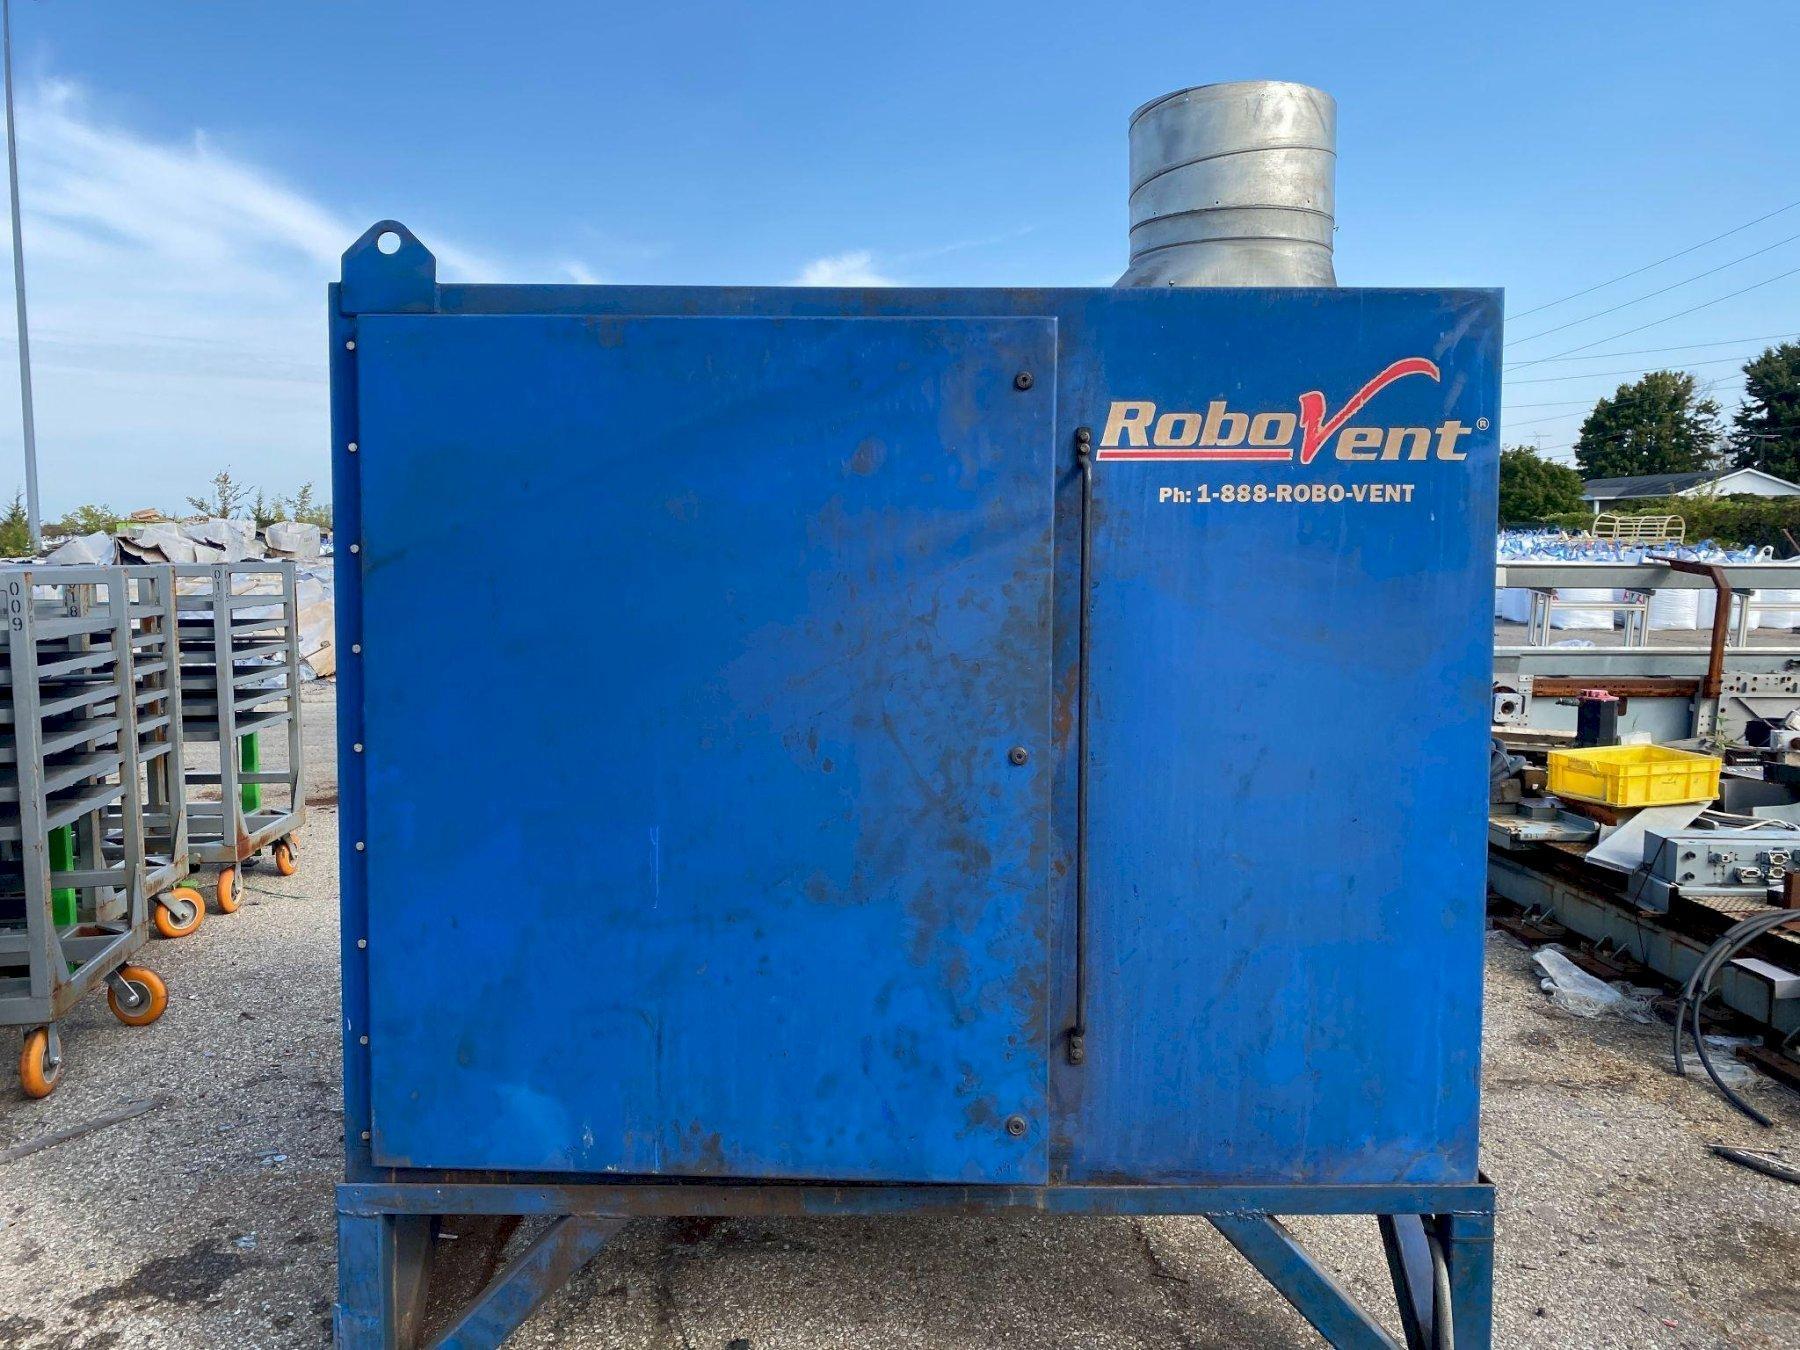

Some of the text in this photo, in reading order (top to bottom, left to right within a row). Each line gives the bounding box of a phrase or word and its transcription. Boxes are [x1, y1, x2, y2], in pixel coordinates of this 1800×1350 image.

[1159, 484, 1415, 503] Ph: 1-888-ROBO-VENT
[10, 582, 22, 631] 009
